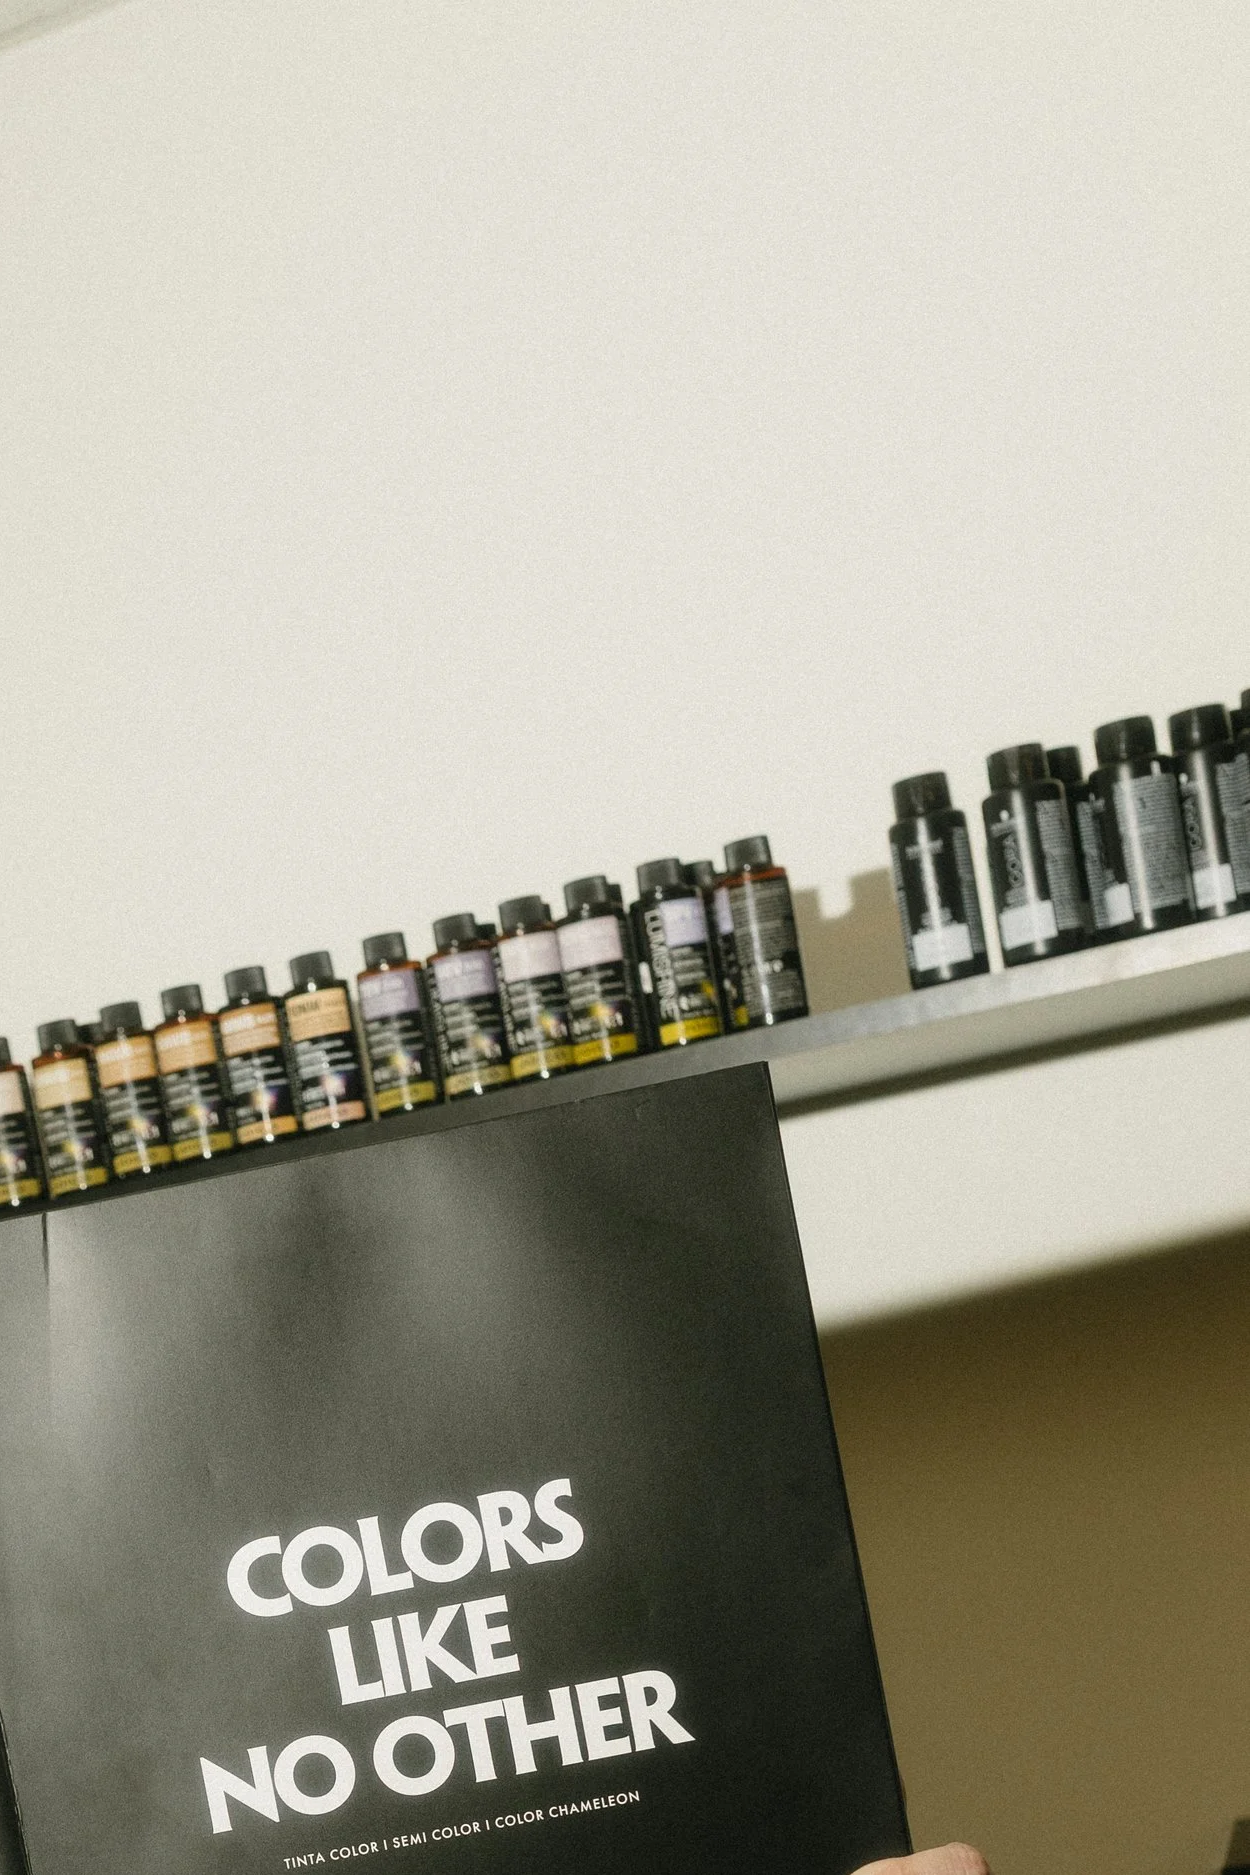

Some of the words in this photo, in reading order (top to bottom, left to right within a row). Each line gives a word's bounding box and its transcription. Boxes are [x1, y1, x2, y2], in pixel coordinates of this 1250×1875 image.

[226, 1478, 584, 1617] COLORS
[327, 1594, 520, 1706] LIKE
[199, 1734, 356, 1834] NO
[372, 1669, 696, 1796] OTHER
[283, 1852, 326, 1870] TINTA
[329, 1841, 379, 1861] COLOR
[392, 1832, 427, 1849] SEMI
[431, 1821, 482, 1842] COLOR
[494, 1809, 545, 1829] COLOR
[548, 1790, 641, 1819] CHAMELEON
